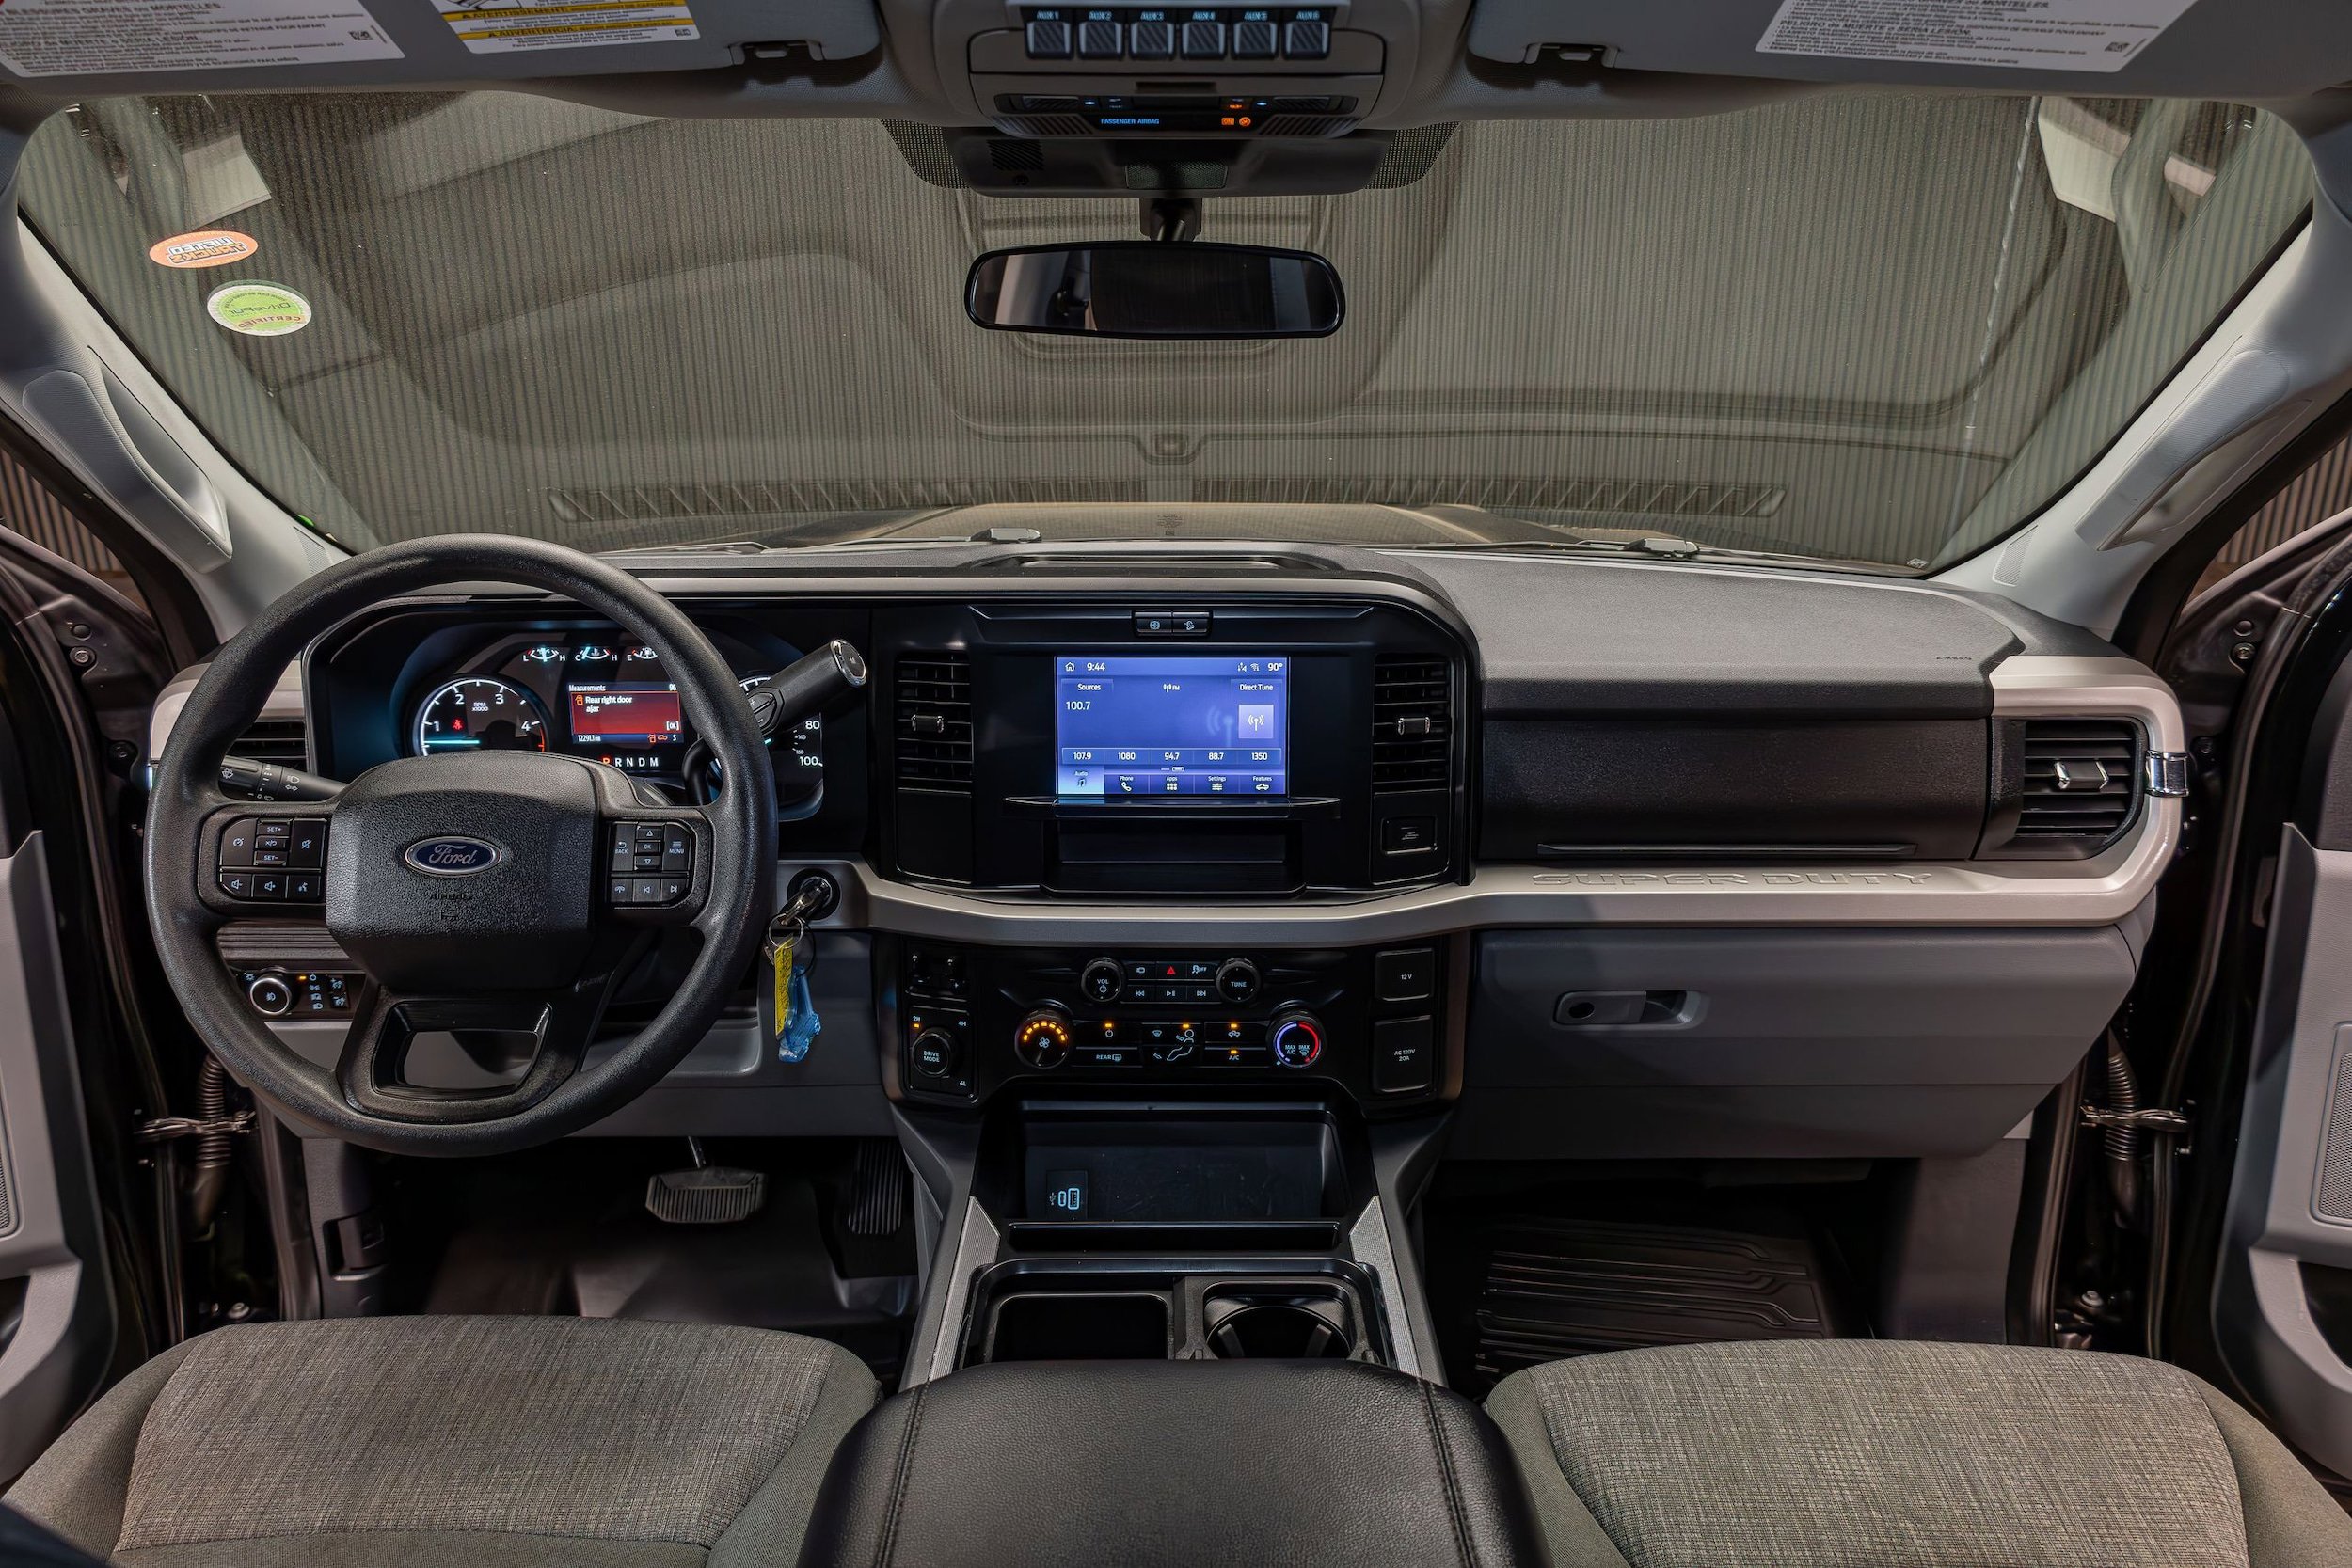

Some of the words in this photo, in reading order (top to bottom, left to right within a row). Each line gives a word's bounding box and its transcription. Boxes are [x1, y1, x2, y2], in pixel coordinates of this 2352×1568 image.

[1087, 662, 1105, 672] 9:44
[1267, 662, 1283, 672] 90°
[568, 684, 607, 692] Measurements
[1077, 683, 1101, 691] Sources
[1239, 683, 1258, 691] Direct
[1258, 683, 1273, 691] Tune
[455, 694, 465, 705] 2
[495, 694, 504, 705] 3
[601, 696, 617, 705] right
[586, 705, 600, 714] ajar
[1066, 701, 1090, 711] 100.7
[434, 721, 440, 732] 1
[521, 721, 532, 732] 4
[805, 720, 820, 730] 80
[800, 756, 818, 767] 100
[1073, 752, 1092, 761] 107.9
[1118, 752, 1136, 761] 1080
[1164, 752, 1180, 761] 94.7
[1208, 752, 1224, 761] 88.7
[1251, 752, 1268, 761] 1350
[614, 757, 623, 767] R
[626, 757, 634, 767] N
[638, 757, 645, 767] D
[649, 757, 659, 767] M
[429, 844, 477, 865] Ford
[1532, 873, 1750, 887] SUPER
[1762, 872, 1933, 887] DUTY
